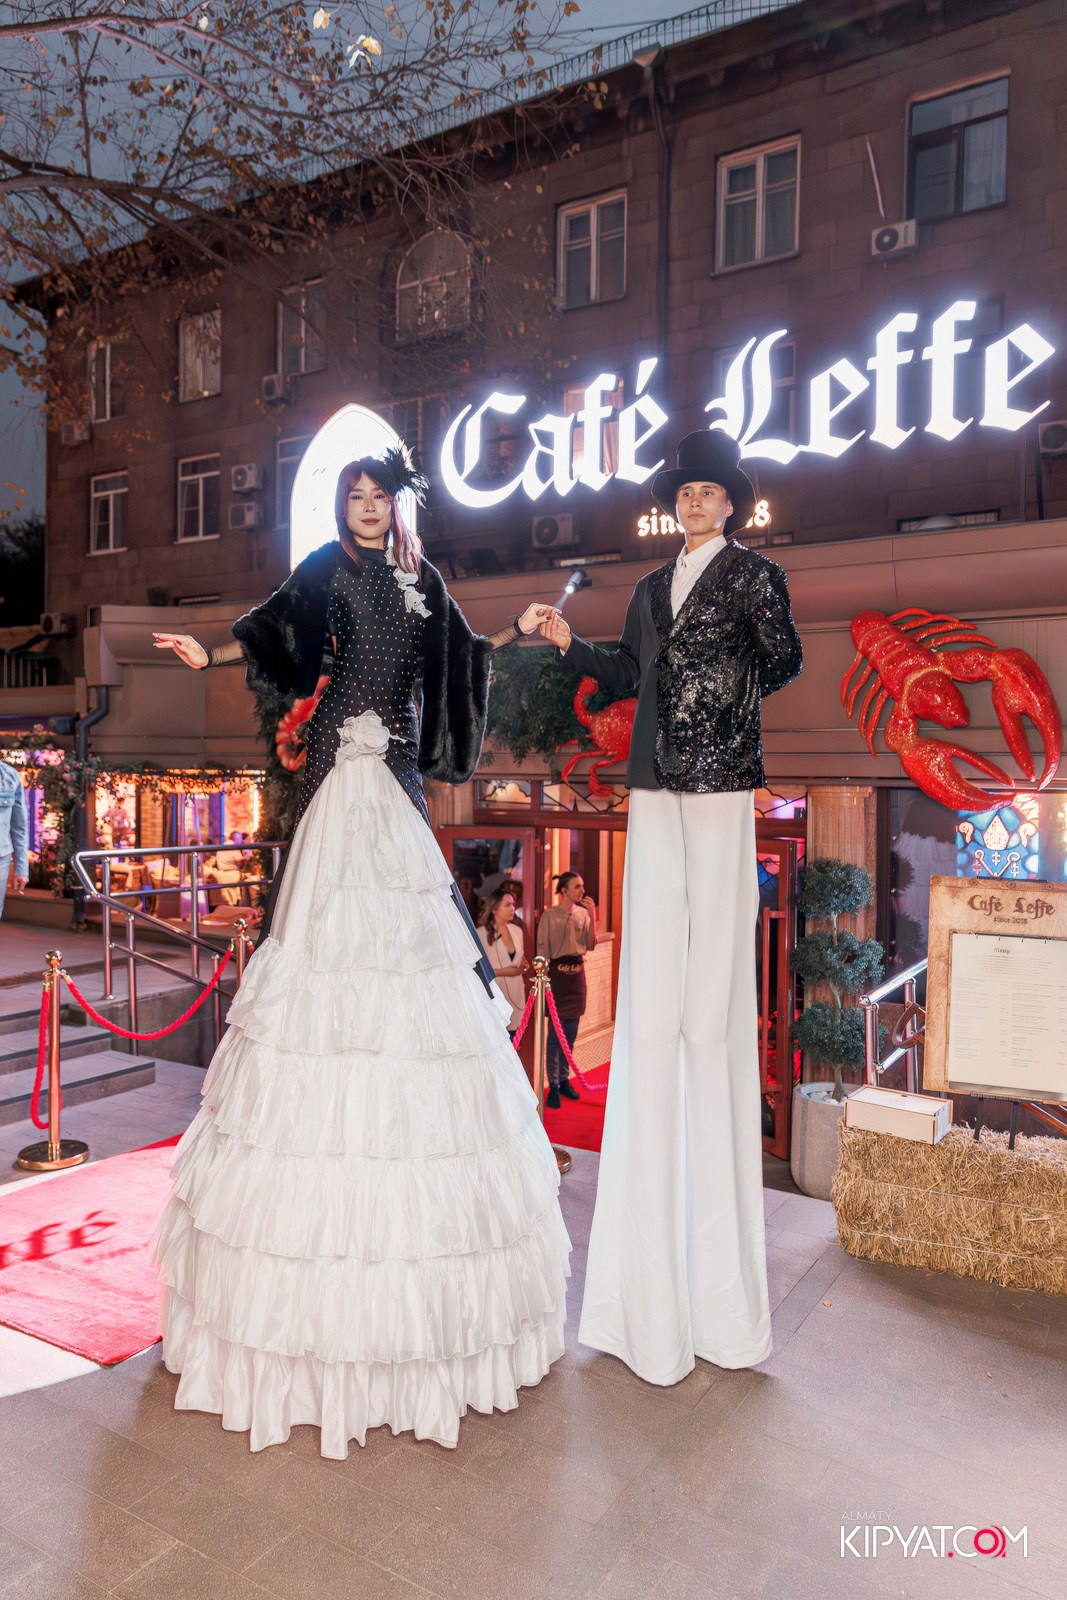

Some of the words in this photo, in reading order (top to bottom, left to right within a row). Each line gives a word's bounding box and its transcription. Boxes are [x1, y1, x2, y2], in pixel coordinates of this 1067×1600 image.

[441, 357, 669, 508] Café
[704, 300, 1056, 465] Leffe
[637, 506, 685, 537] sin
[967, 894, 1004, 917] Café
[1012, 897, 1056, 920] Leffe
